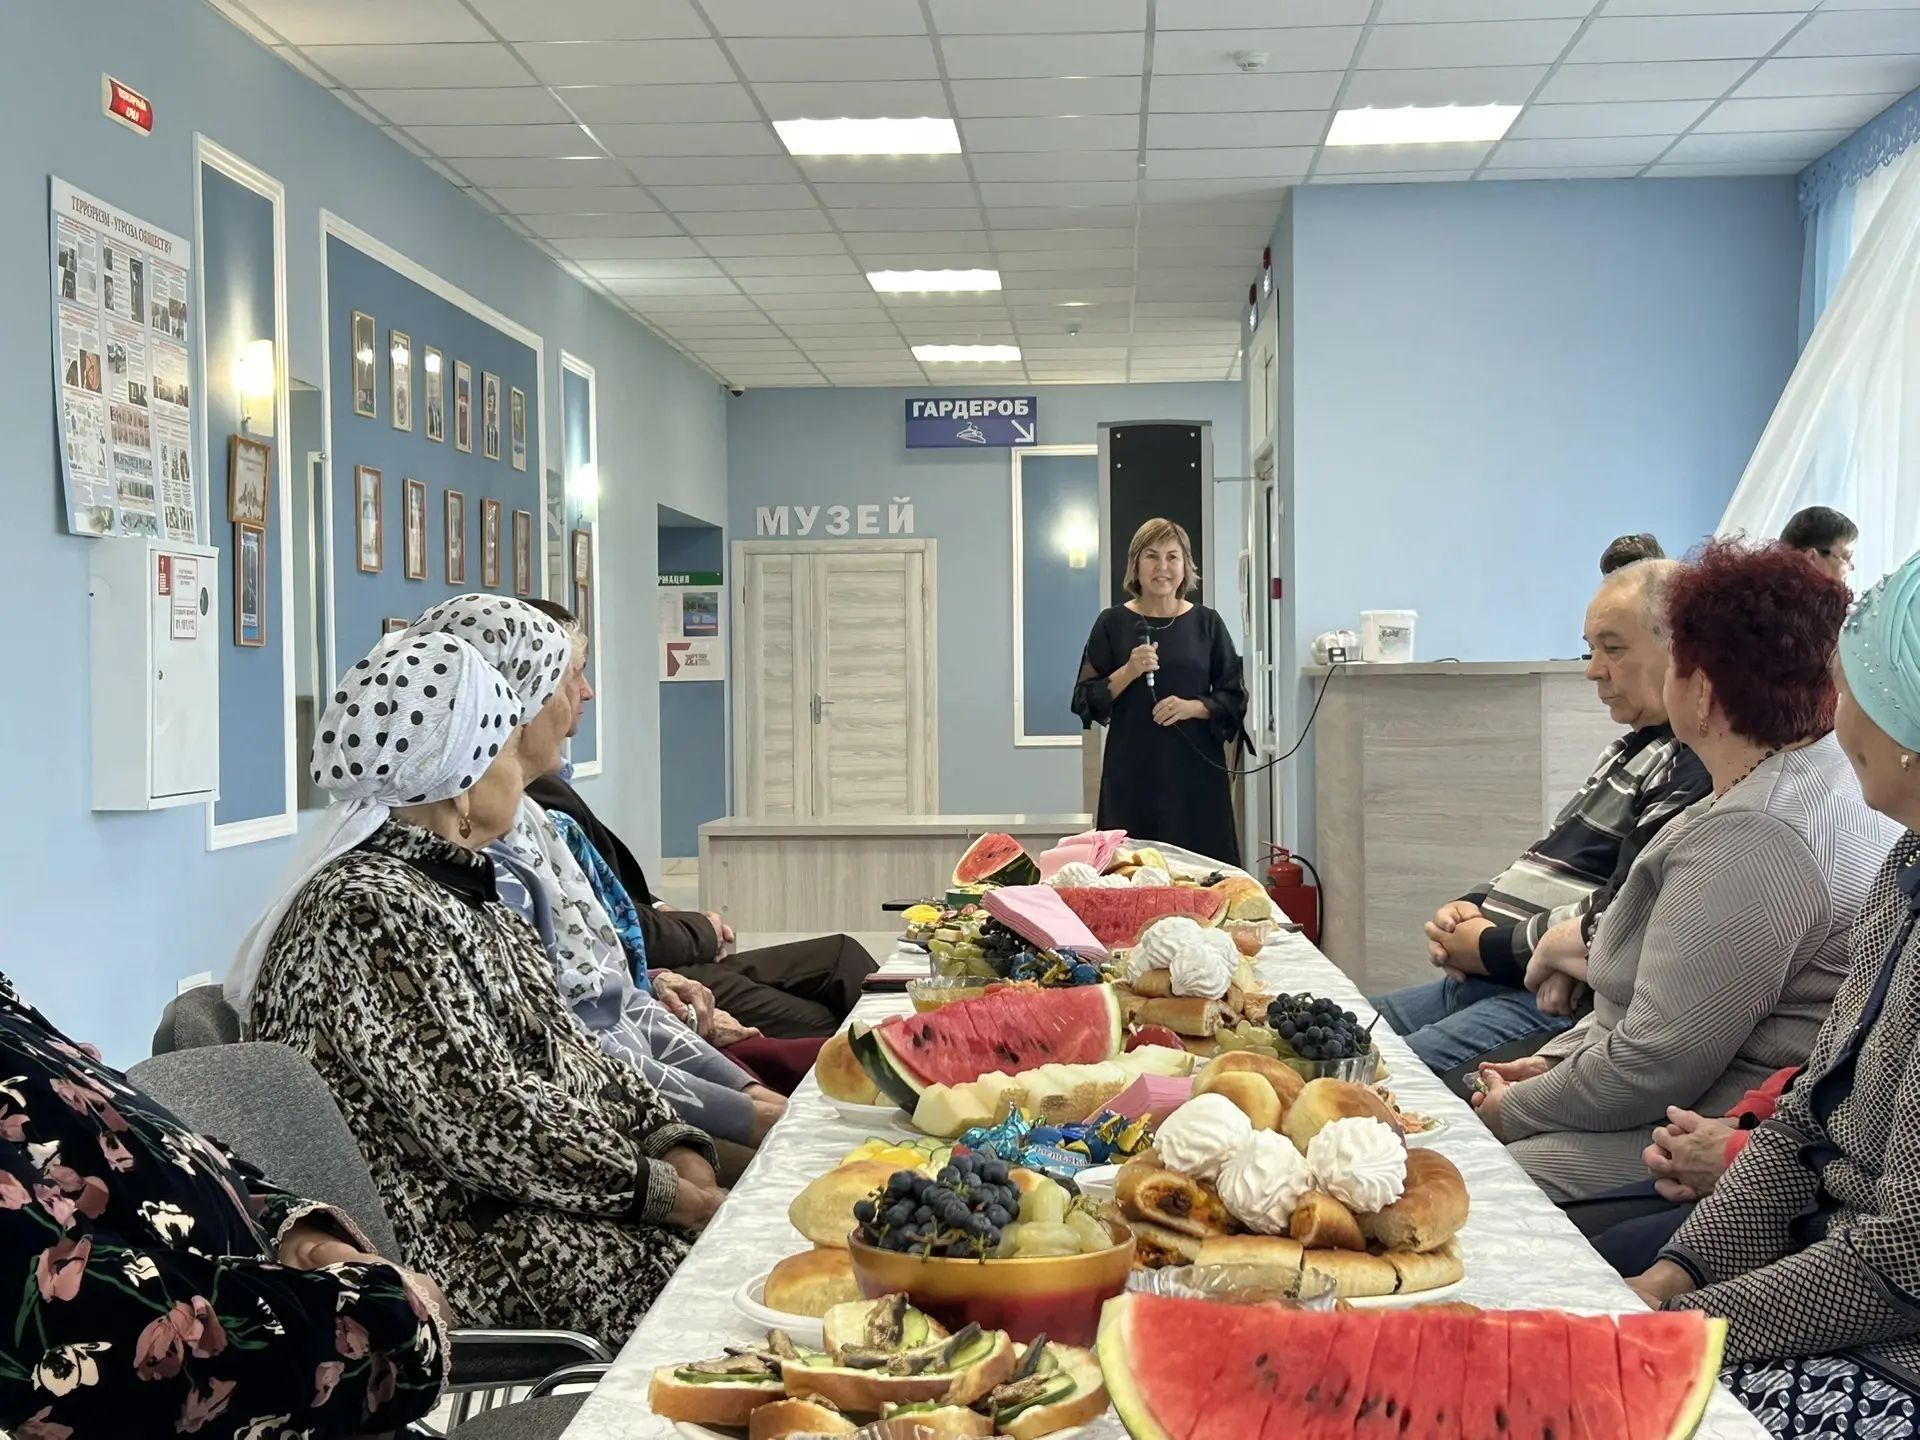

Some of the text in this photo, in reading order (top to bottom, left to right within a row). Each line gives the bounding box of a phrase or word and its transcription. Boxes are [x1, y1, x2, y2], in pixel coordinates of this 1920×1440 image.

[71, 195, 110, 227] ТЕРРОРИЗМ
[114, 216, 138, 240] УГРОЗА
[138, 228, 173, 256] ОБЩЕСТВУ
[912, 399, 1029, 419] ГАРДЕРОБ
[756, 496, 914, 536] МУЗЕЙ
